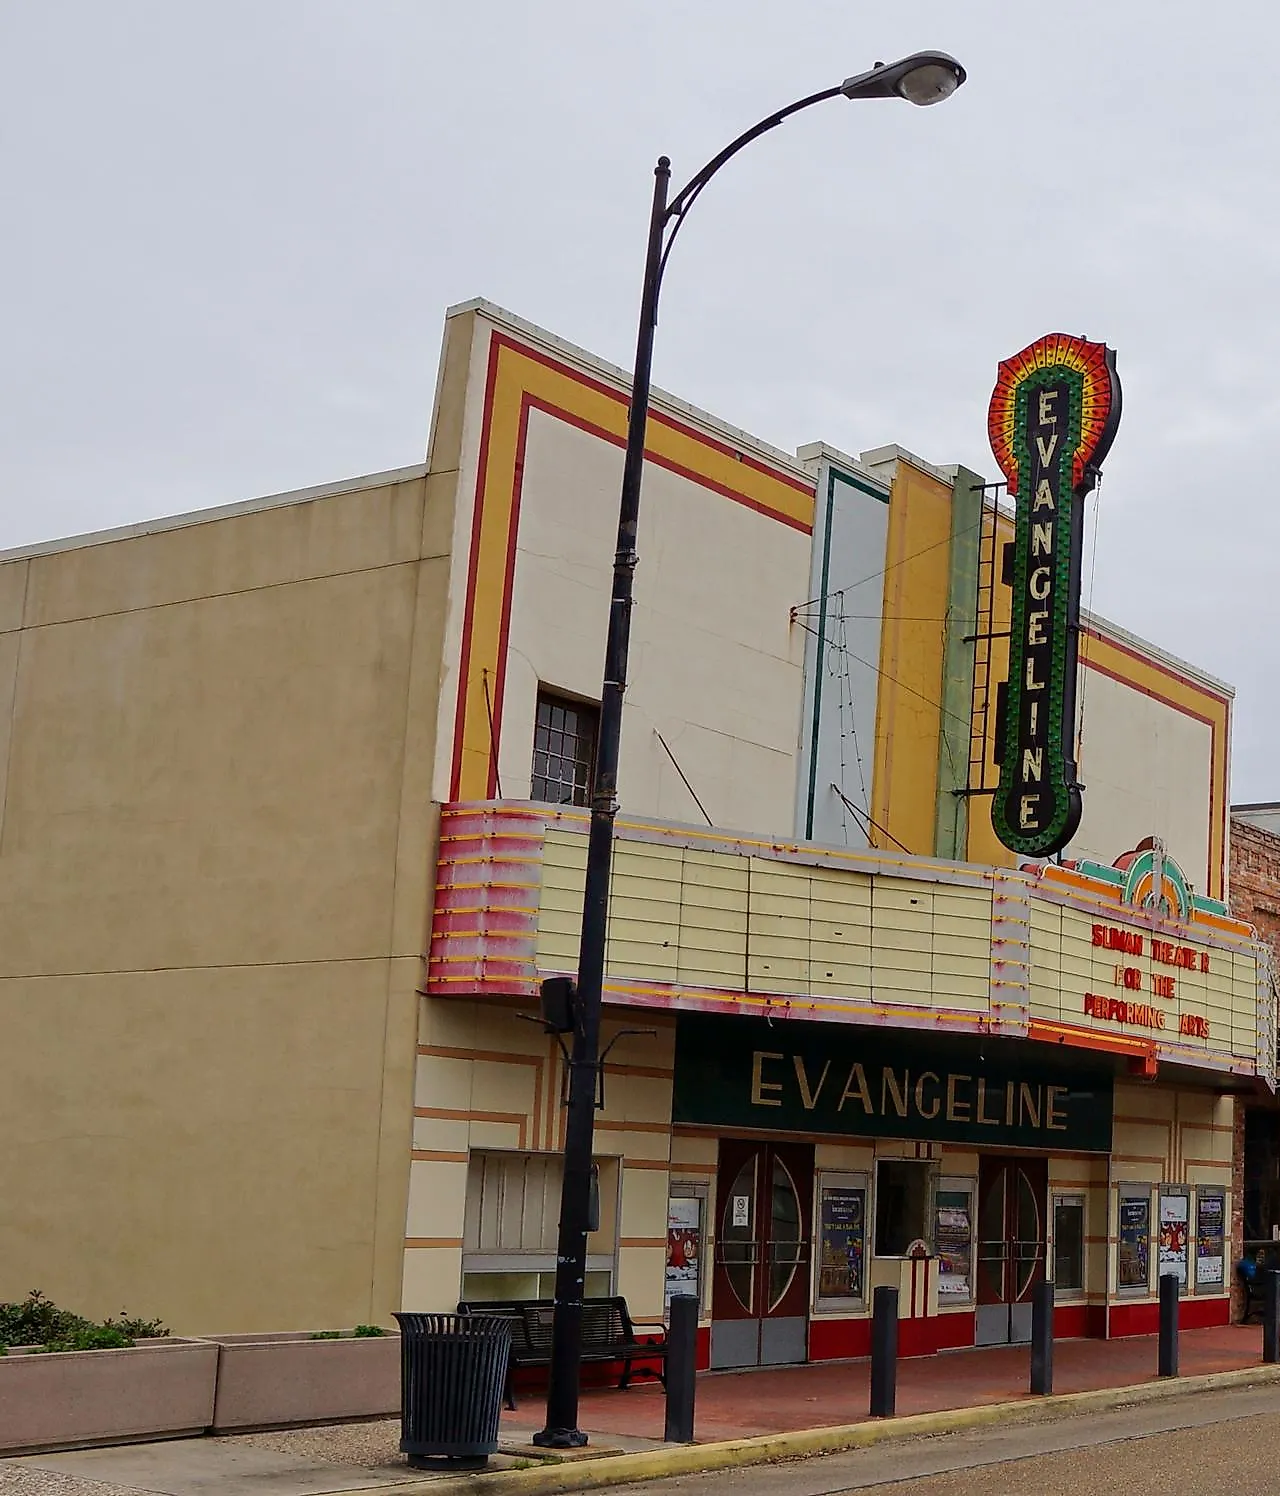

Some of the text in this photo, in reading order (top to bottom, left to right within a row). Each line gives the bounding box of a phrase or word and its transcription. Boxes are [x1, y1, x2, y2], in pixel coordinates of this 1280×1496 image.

[1019, 390, 1058, 829] EVANGELINE
[1092, 924, 1143, 956] SLIMAN
[1114, 964, 1176, 999] FOR THE
[1084, 993, 1210, 1039] PERFORMING ARTS
[750, 1051, 1068, 1130] EVANGELINE
